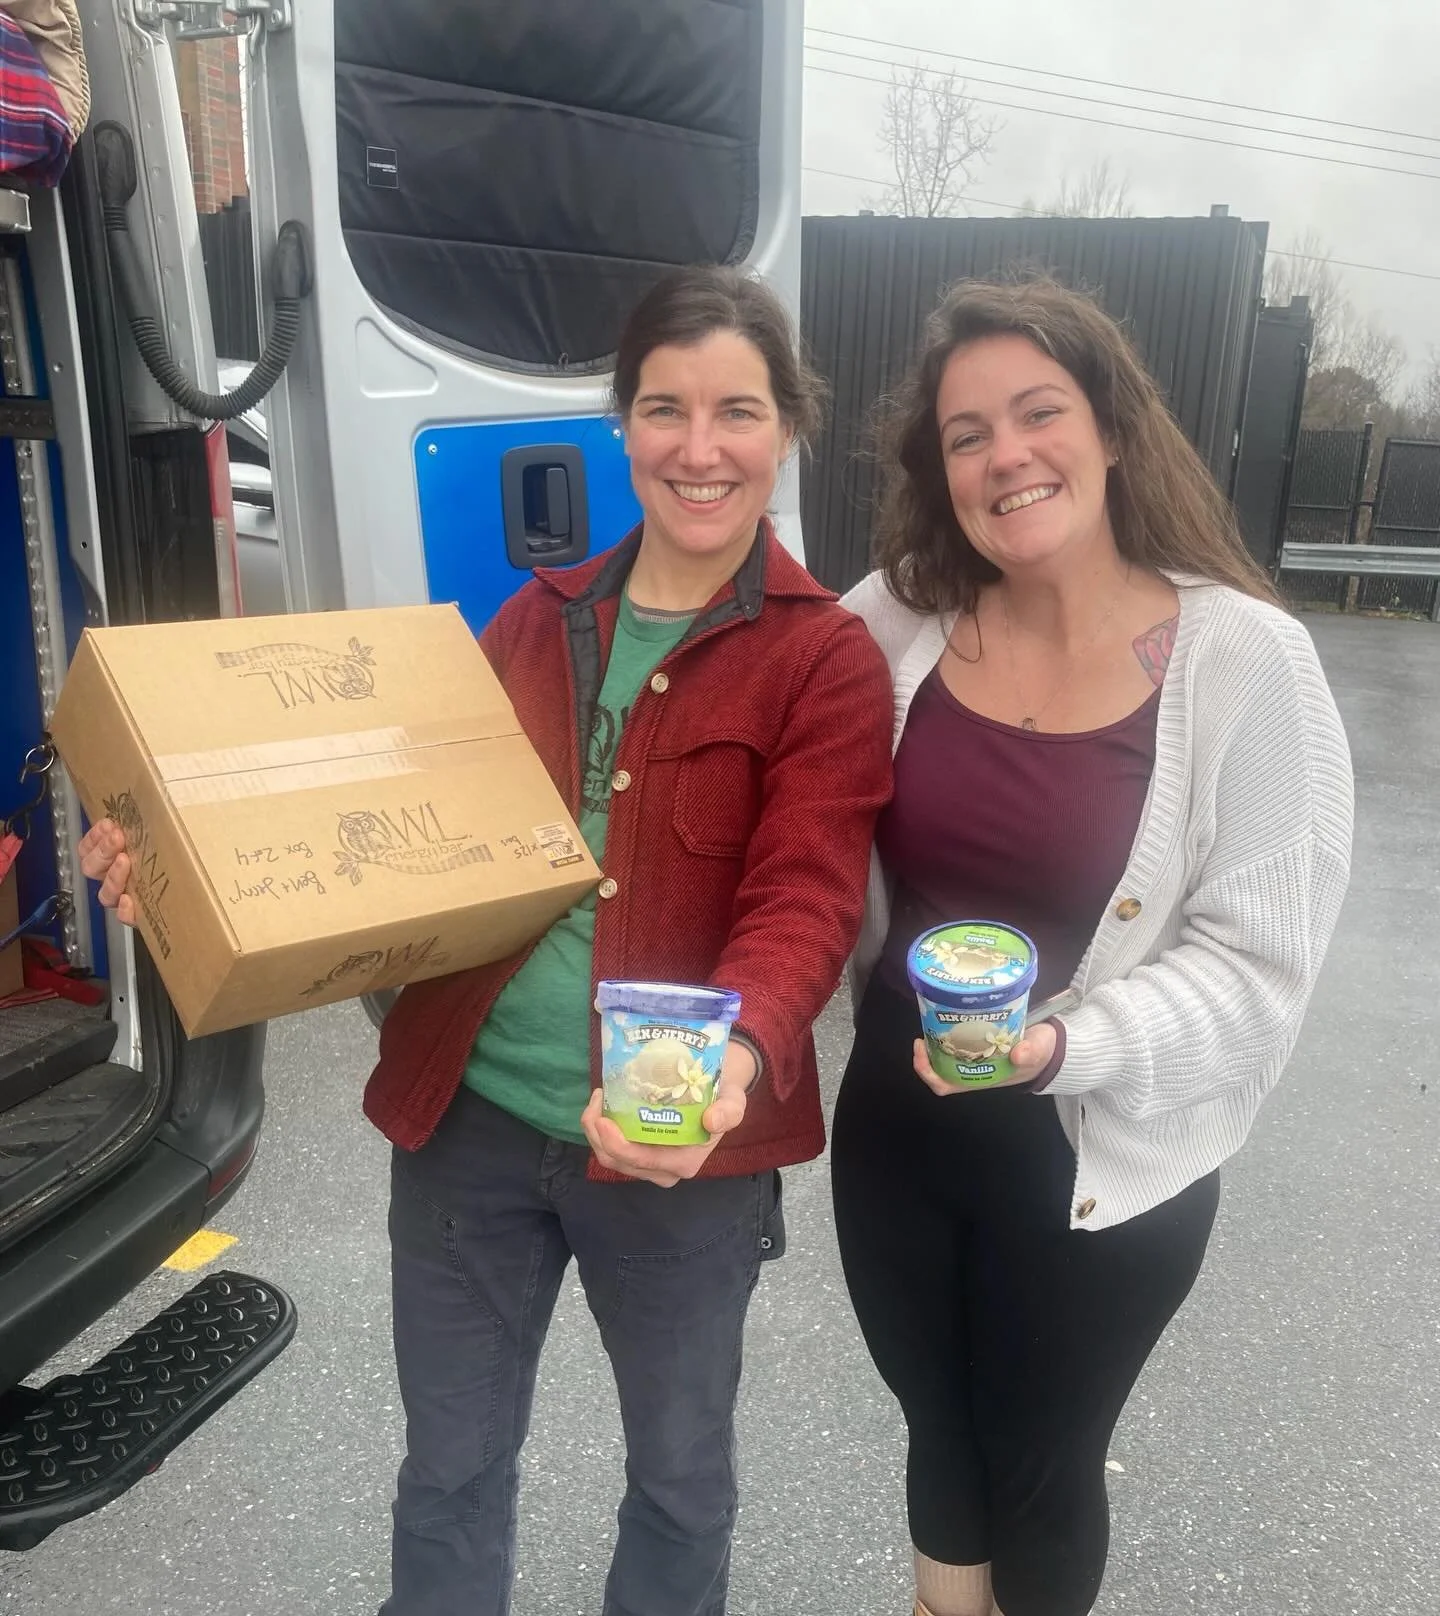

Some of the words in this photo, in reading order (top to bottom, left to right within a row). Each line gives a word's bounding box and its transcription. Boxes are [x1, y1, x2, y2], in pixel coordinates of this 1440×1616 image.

[234, 847, 250, 866] 4
[263, 847, 280, 863] 2
[284, 841, 314, 859] Box
[287, 870, 327, 896] Ben
[957, 1064, 995, 1075] Vanilla
[639, 1108, 682, 1124] Vanilla
